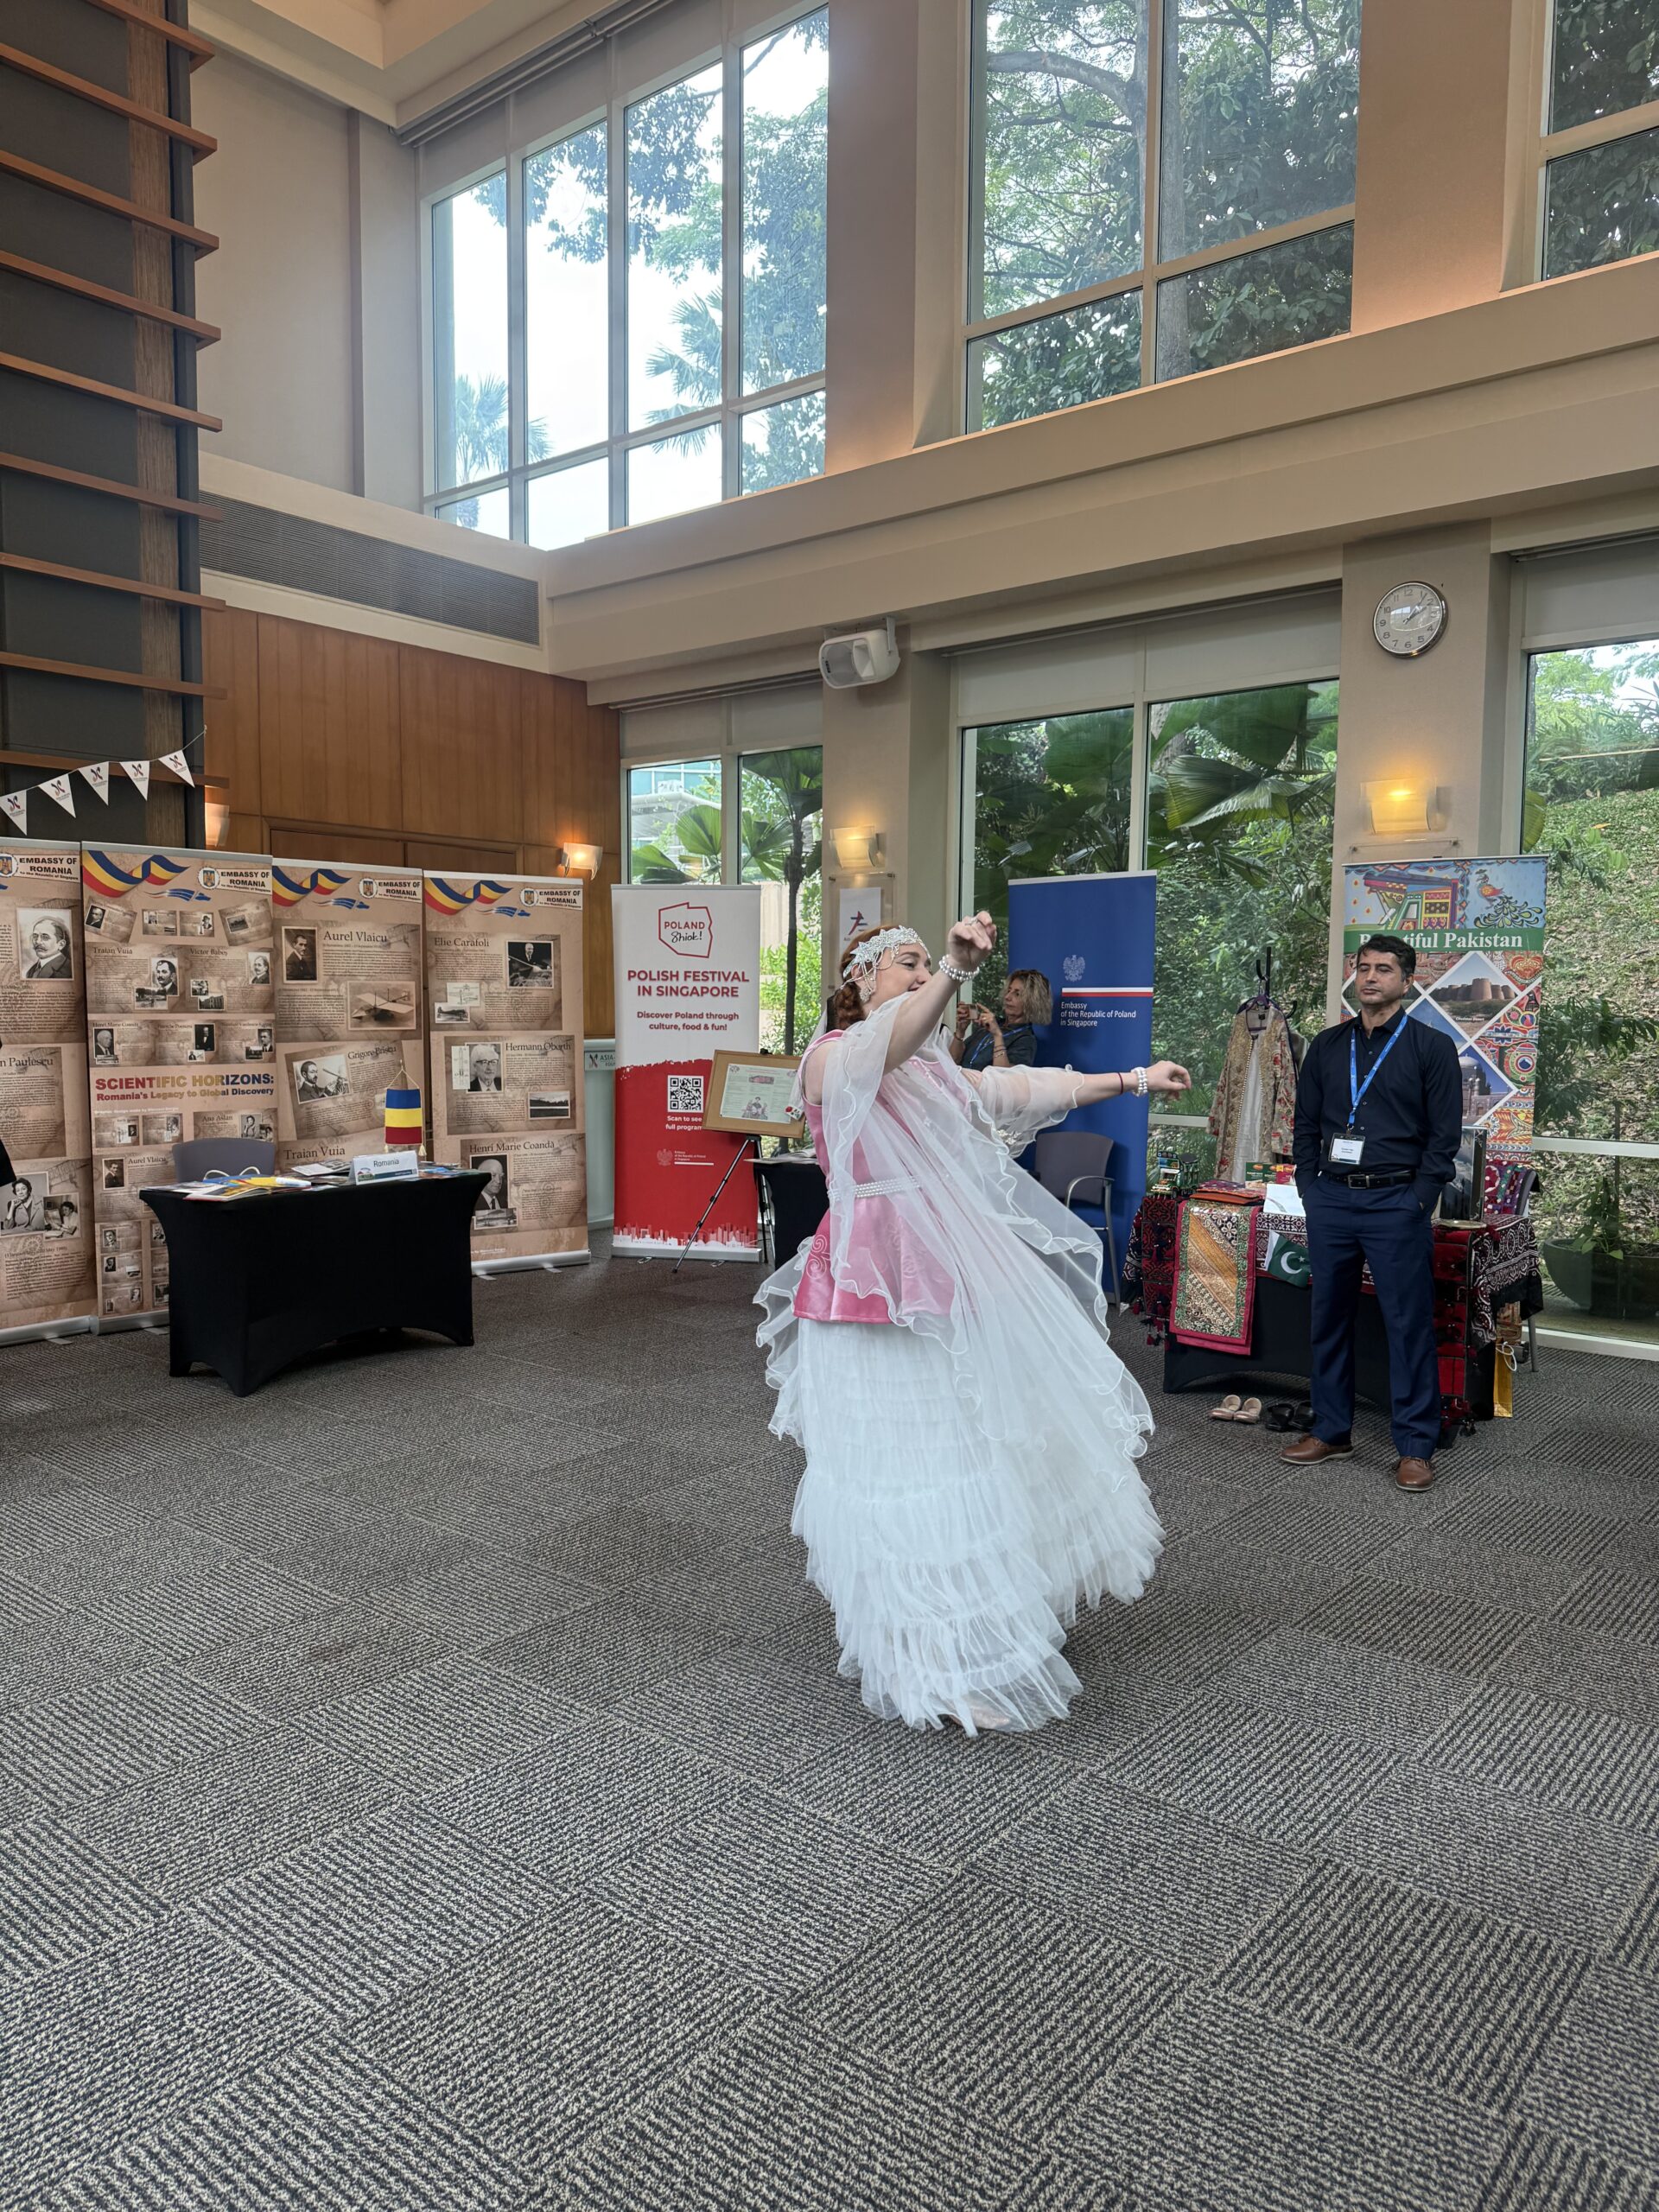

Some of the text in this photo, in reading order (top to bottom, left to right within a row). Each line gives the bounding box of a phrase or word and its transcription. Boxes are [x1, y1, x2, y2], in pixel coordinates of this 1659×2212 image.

[1380, 619, 1386, 627] 9
[29, 866, 73, 874] ROMANIA
[664, 921, 705, 930] POLAND
[323, 931, 387, 942] Aurel Vlaicu
[1359, 932, 1522, 949] Btiful Pakistan
[435, 937, 489, 947] Elie Carafoli
[627, 970, 749, 982] POLISH FESTIVAL
[637, 985, 740, 997] IN SINGAPORE
[1061, 1001, 1087, 1010] Embassy
[706, 1012, 740, 1020] through
[1080, 1010, 1106, 1019] Republic
[1067, 1019, 1097, 1027] Singapore
[505, 1041, 571, 1051] Hermann Oberth
[9, 1057, 54, 1066] Paulescu
[95, 1073, 274, 1090] SCIENTIFIC HORIZONS:
[97, 1091, 148, 1101] Romania's
[150, 1090, 185, 1100] Legacy
[200, 1089, 229, 1097] Global
[232, 1087, 274, 1096] Discovery
[469, 1143, 493, 1153] Henri
[496, 1142, 521, 1151] Marie
[283, 1147, 346, 1160] Traian Vuia
[373, 1158, 400, 1167] Romania
